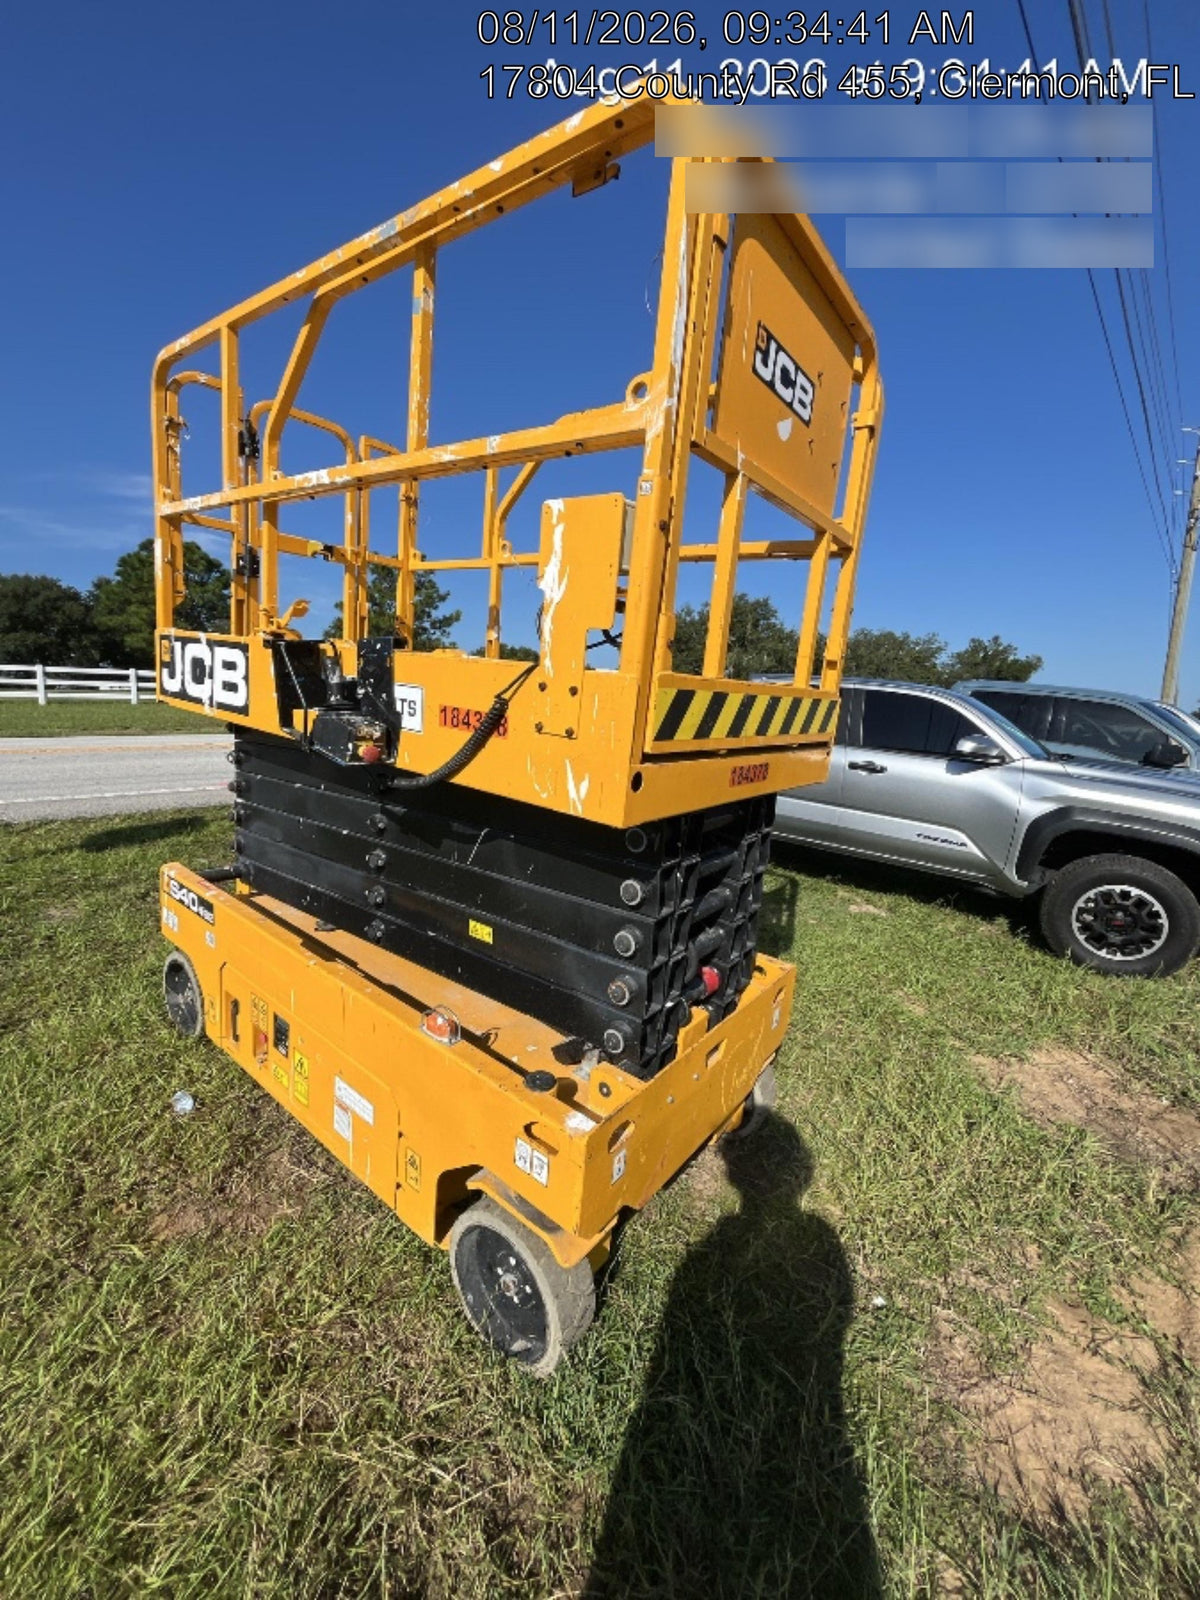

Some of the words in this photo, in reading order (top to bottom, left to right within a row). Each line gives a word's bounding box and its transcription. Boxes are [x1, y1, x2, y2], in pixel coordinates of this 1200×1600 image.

[755, 339, 813, 422] JCB
[161, 640, 247, 707] JCB
[440, 705, 509, 737] 18438
